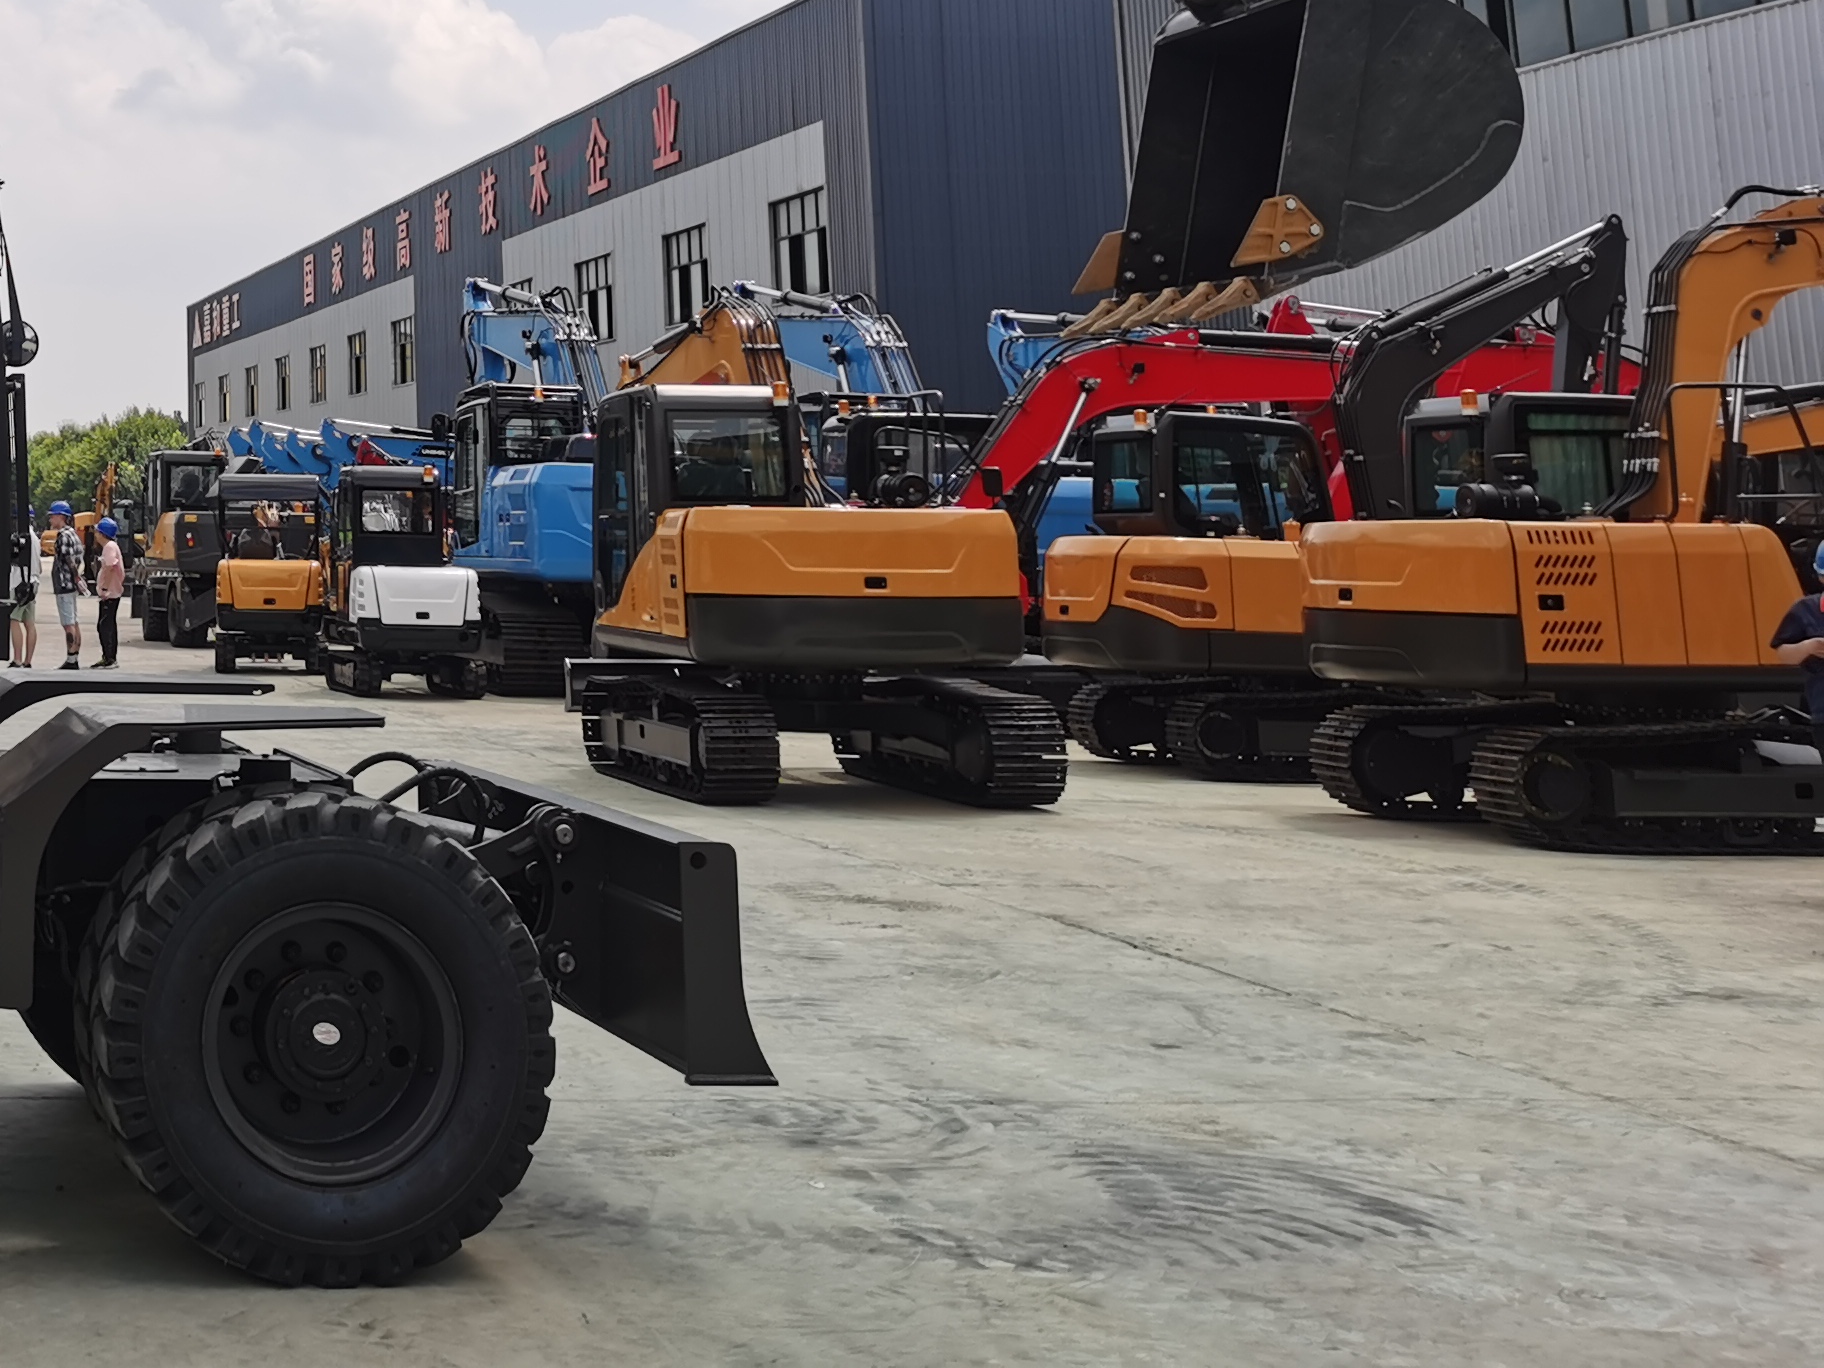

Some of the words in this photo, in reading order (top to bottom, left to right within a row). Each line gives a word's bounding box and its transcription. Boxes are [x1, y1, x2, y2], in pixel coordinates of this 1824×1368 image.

[303, 83, 680, 307] 国家级高新技术企业
